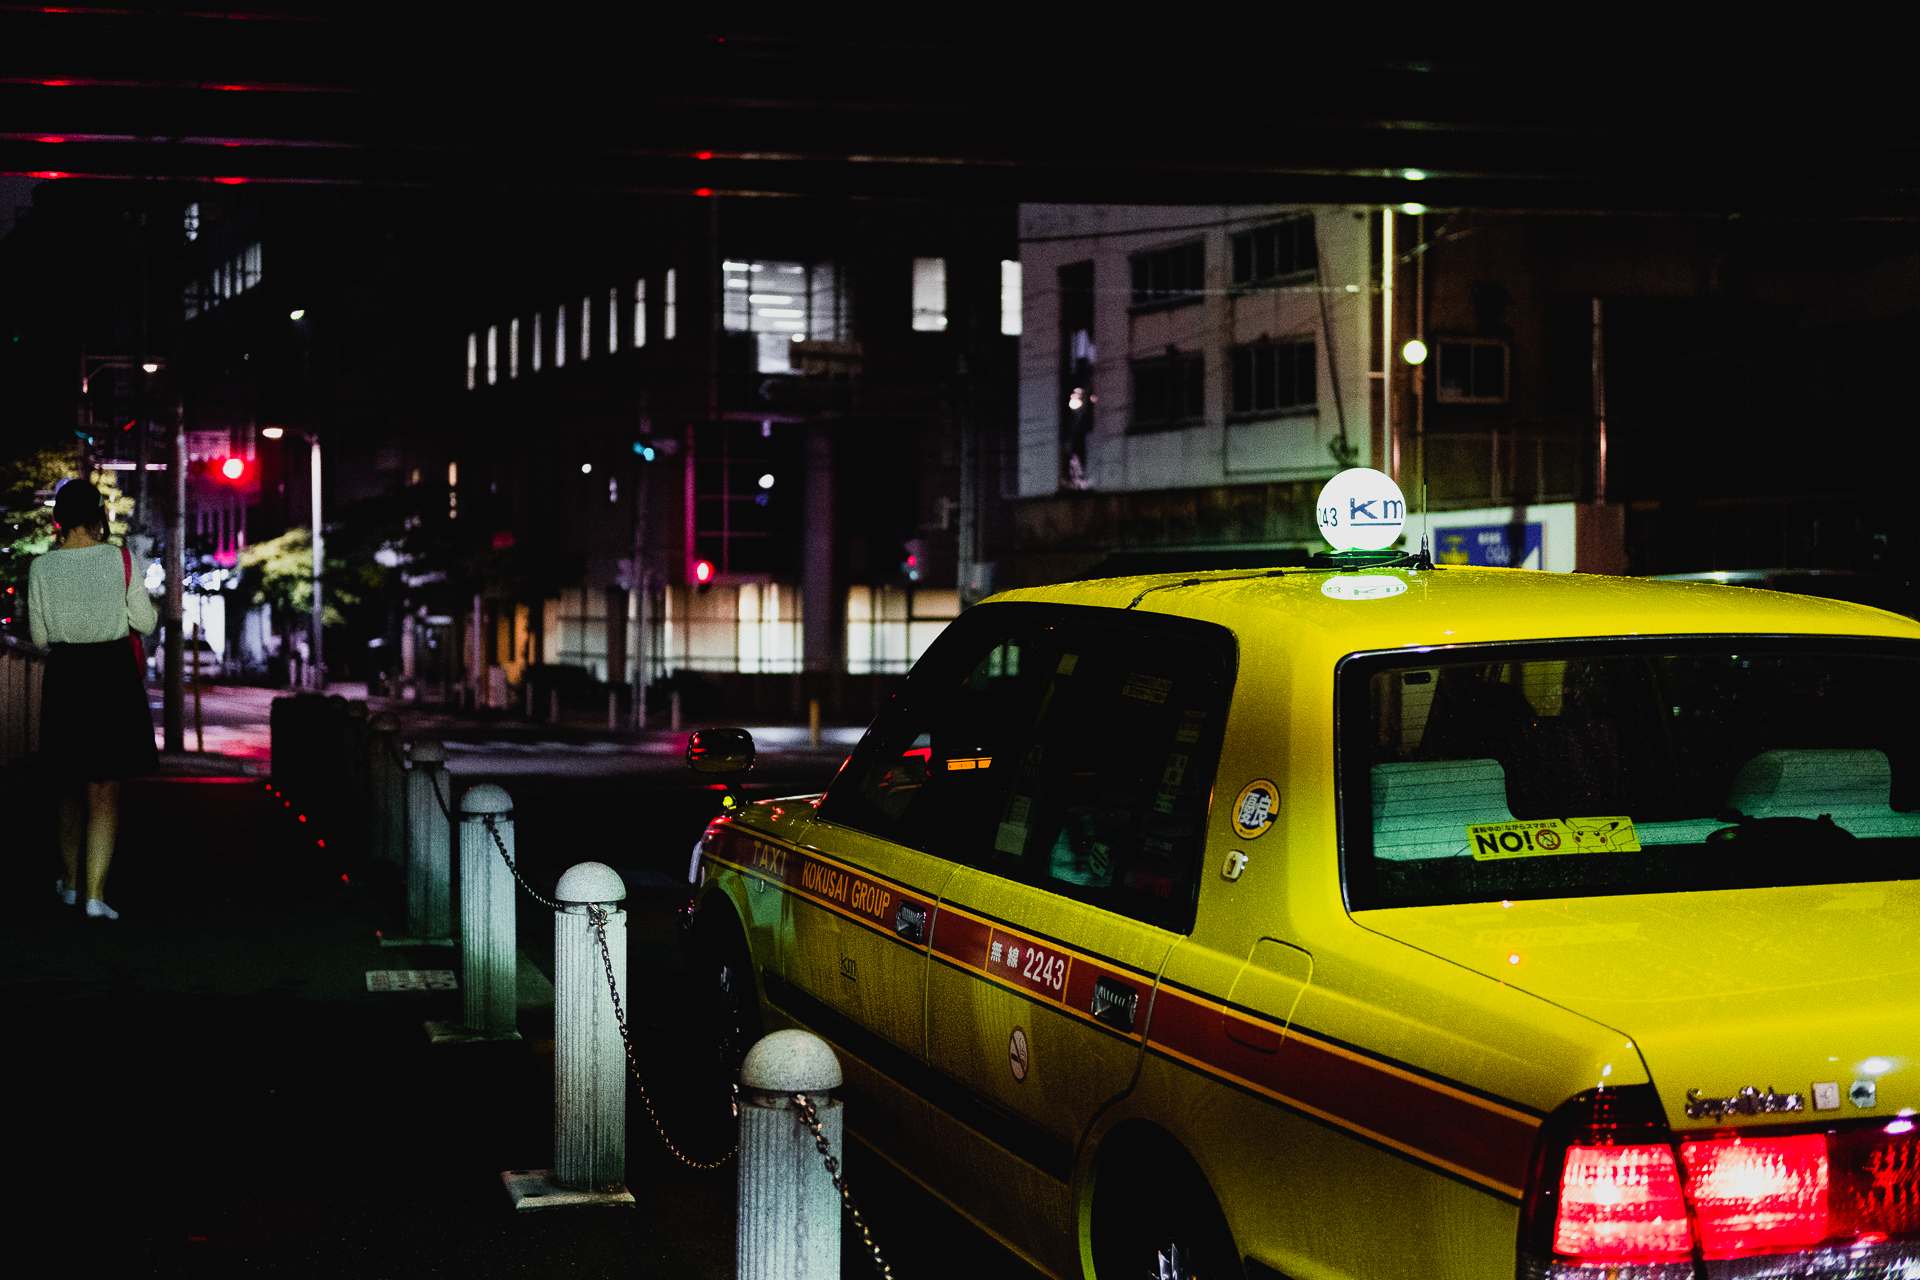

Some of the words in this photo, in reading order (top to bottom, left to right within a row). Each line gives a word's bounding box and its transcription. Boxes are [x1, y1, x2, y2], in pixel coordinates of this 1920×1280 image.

[753, 840, 787, 877] TAXI
[1475, 831, 1534, 854] NO!
[801, 860, 849, 904] KOKUSAI
[851, 879, 891, 920] GROUP
[1023, 947, 1065, 991] 2243
